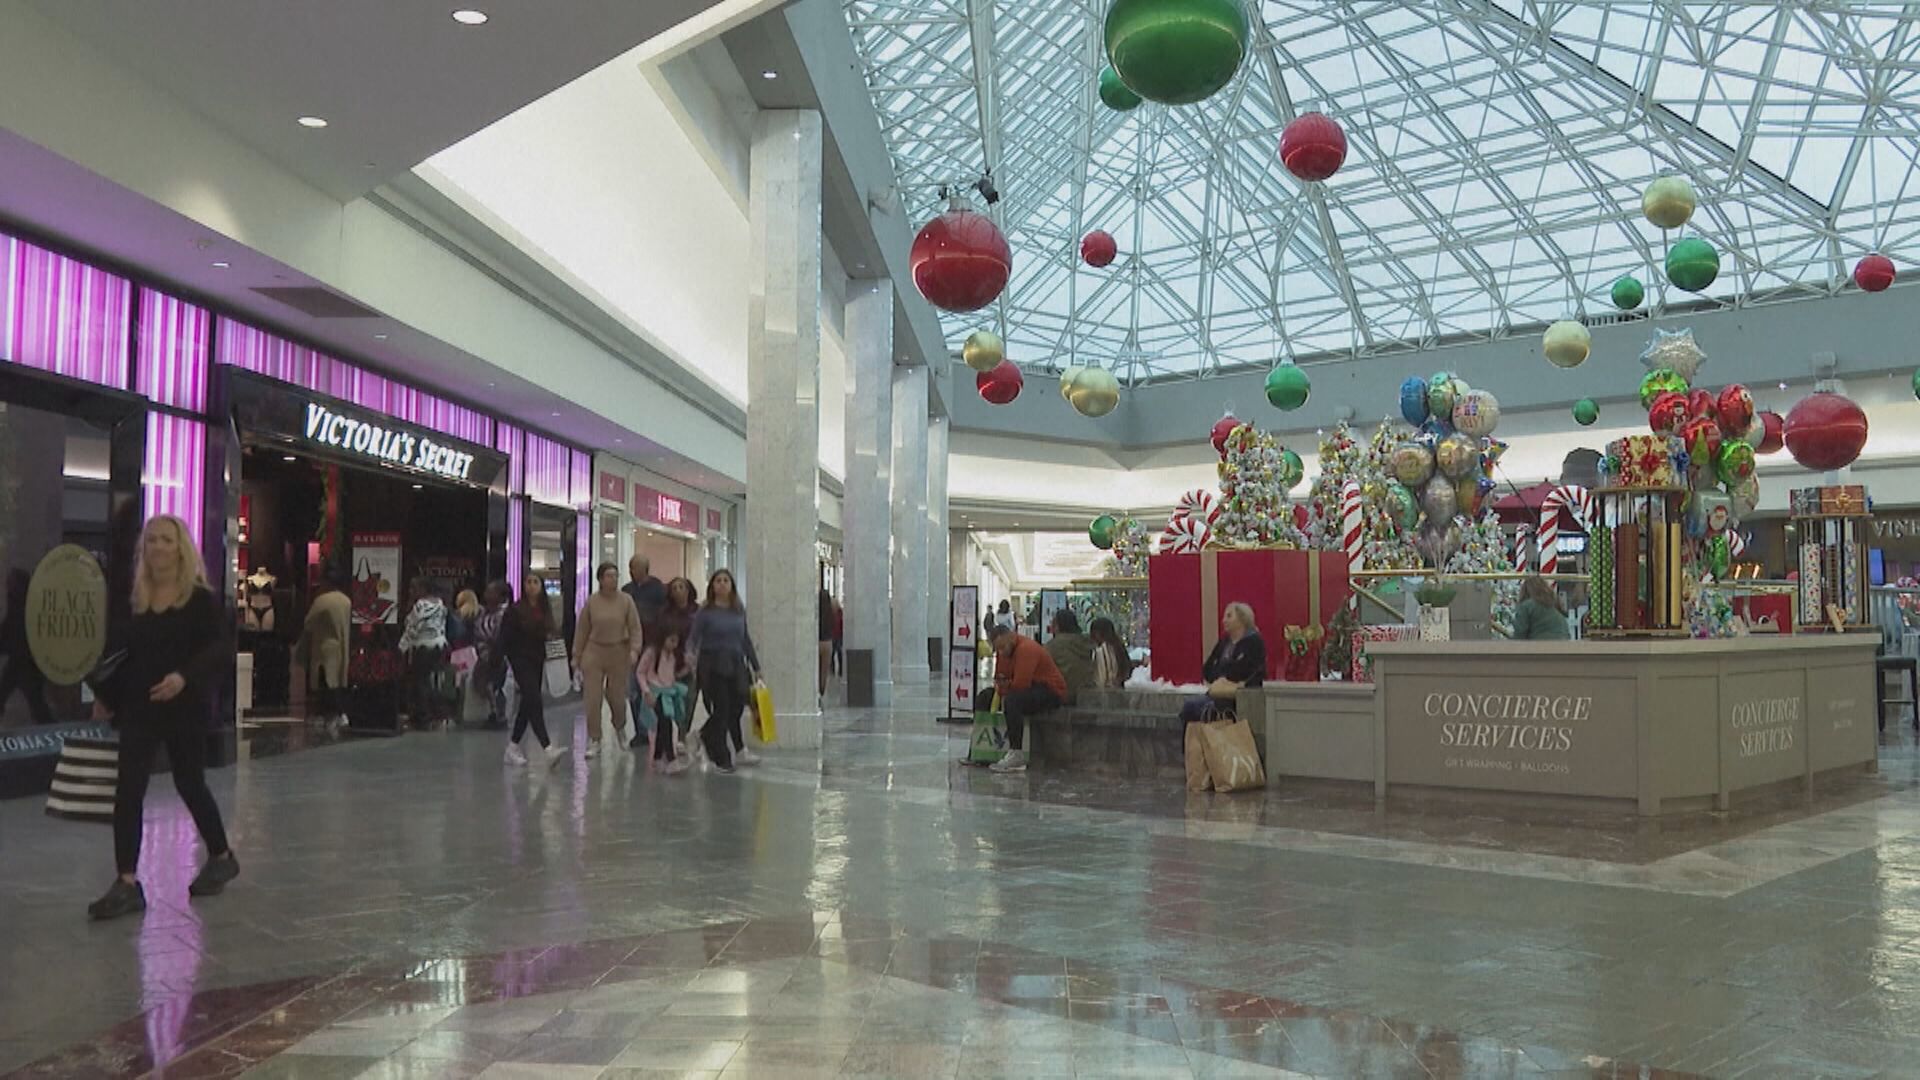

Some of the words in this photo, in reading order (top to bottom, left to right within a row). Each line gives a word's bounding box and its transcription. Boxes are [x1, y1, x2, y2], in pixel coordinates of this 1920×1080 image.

[305, 403, 415, 465] VICTORIA'S
[416, 437, 474, 480] SECRET
[42, 588, 96, 615] BLACK
[37, 613, 97, 640] FRIDAY
[1424, 692, 1593, 721] CONCIERGE
[1731, 697, 1800, 729] CONCIERGE
[1440, 721, 1573, 752] SERVICES
[1739, 725, 1794, 758] SERVICES
[1466, 758, 1513, 771] WRAPPING
[1520, 762, 1571, 774] BALLOONS
